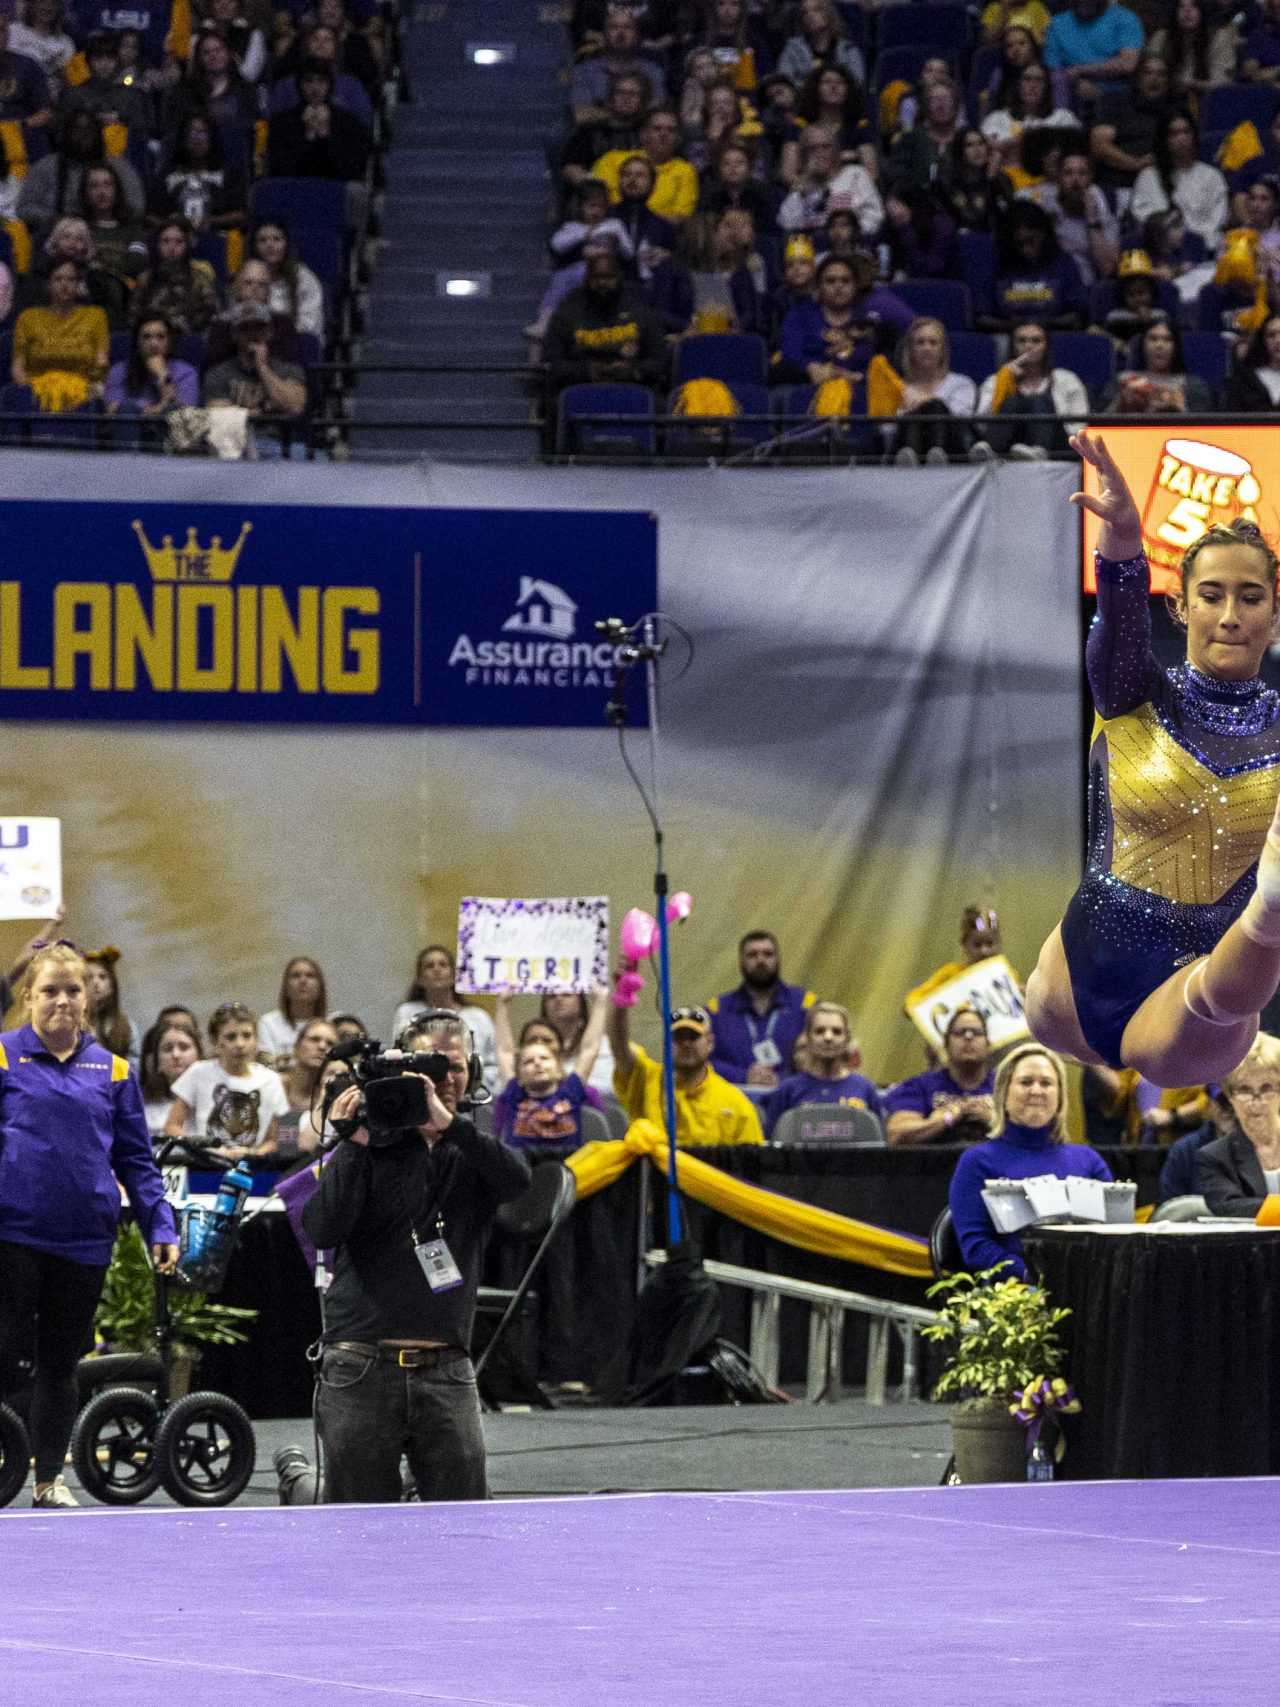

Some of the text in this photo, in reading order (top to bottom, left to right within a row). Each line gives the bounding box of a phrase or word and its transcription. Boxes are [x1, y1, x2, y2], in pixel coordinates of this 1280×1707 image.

[1158, 455, 1236, 507] TAKE
[1156, 497, 1211, 551] 5
[175, 555, 210, 577] THE
[0, 580, 381, 693] LANDING
[465, 666, 617, 688] FINANCIAL
